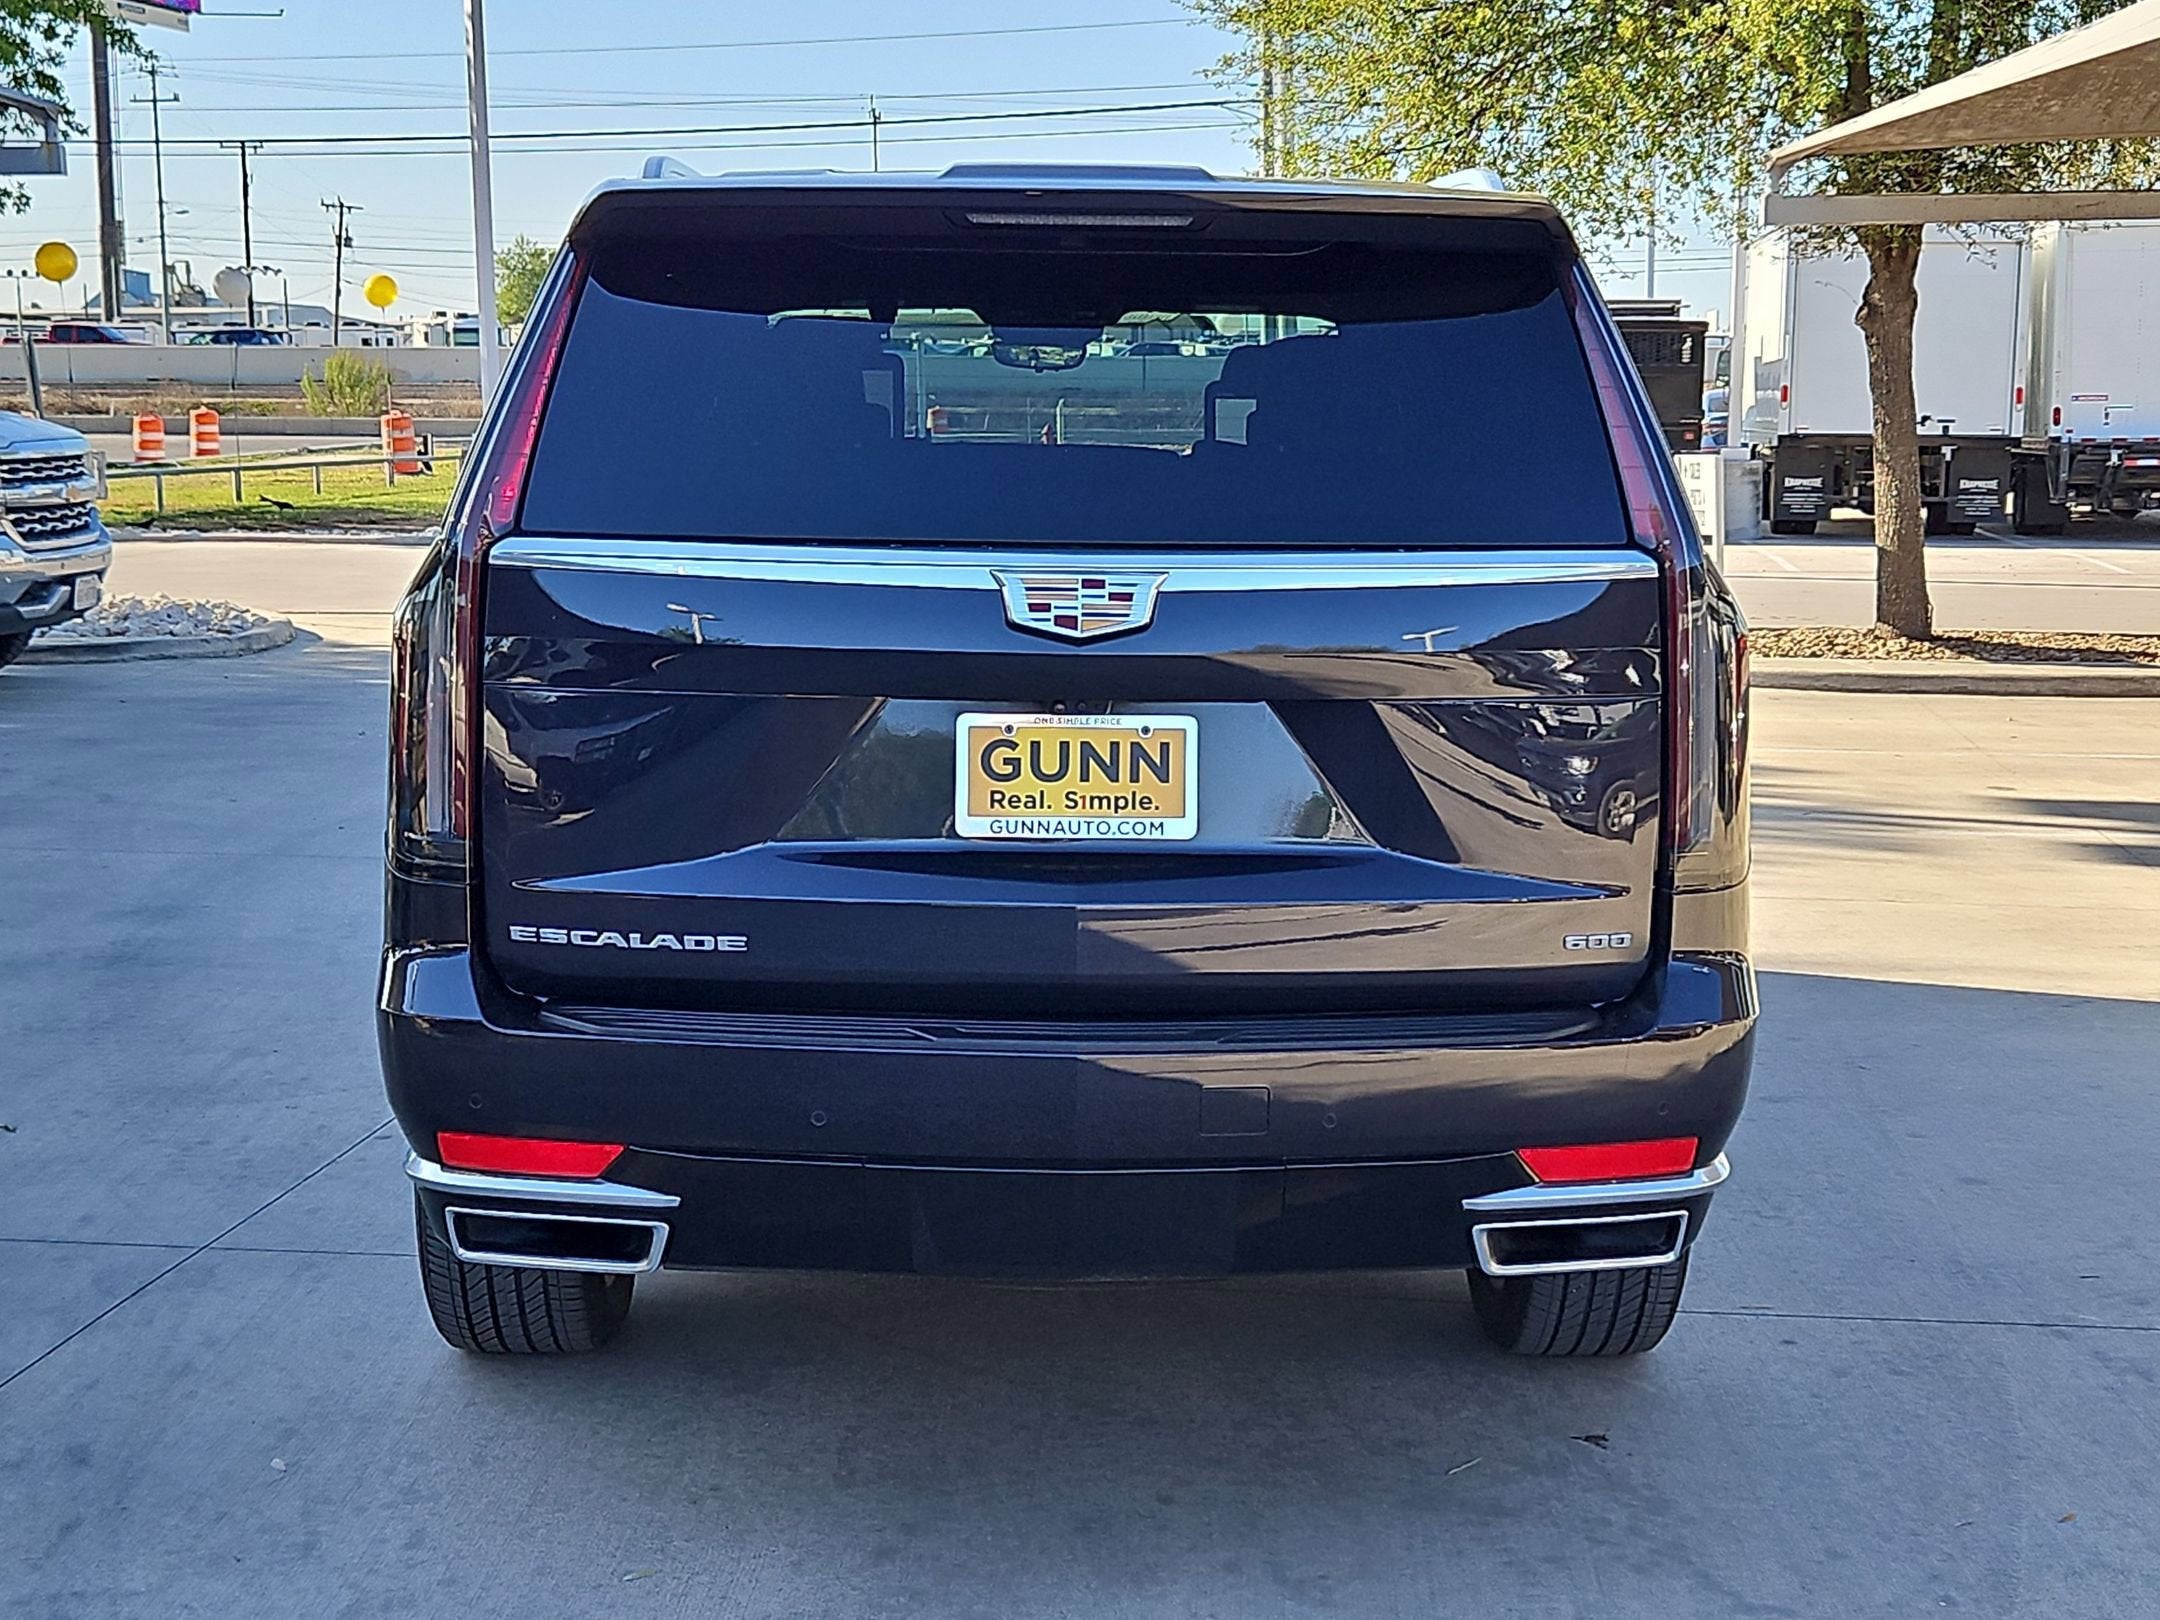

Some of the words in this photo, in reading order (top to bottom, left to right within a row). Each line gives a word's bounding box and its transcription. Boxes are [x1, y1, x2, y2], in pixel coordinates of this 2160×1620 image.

[980, 738, 1170, 784] GUNN
[989, 790, 1053, 810] Real.
[989, 819, 1164, 836] GUNNAUTO.COM
[509, 925, 748, 951] ESCALADE
[1563, 933, 1632, 950] 600
